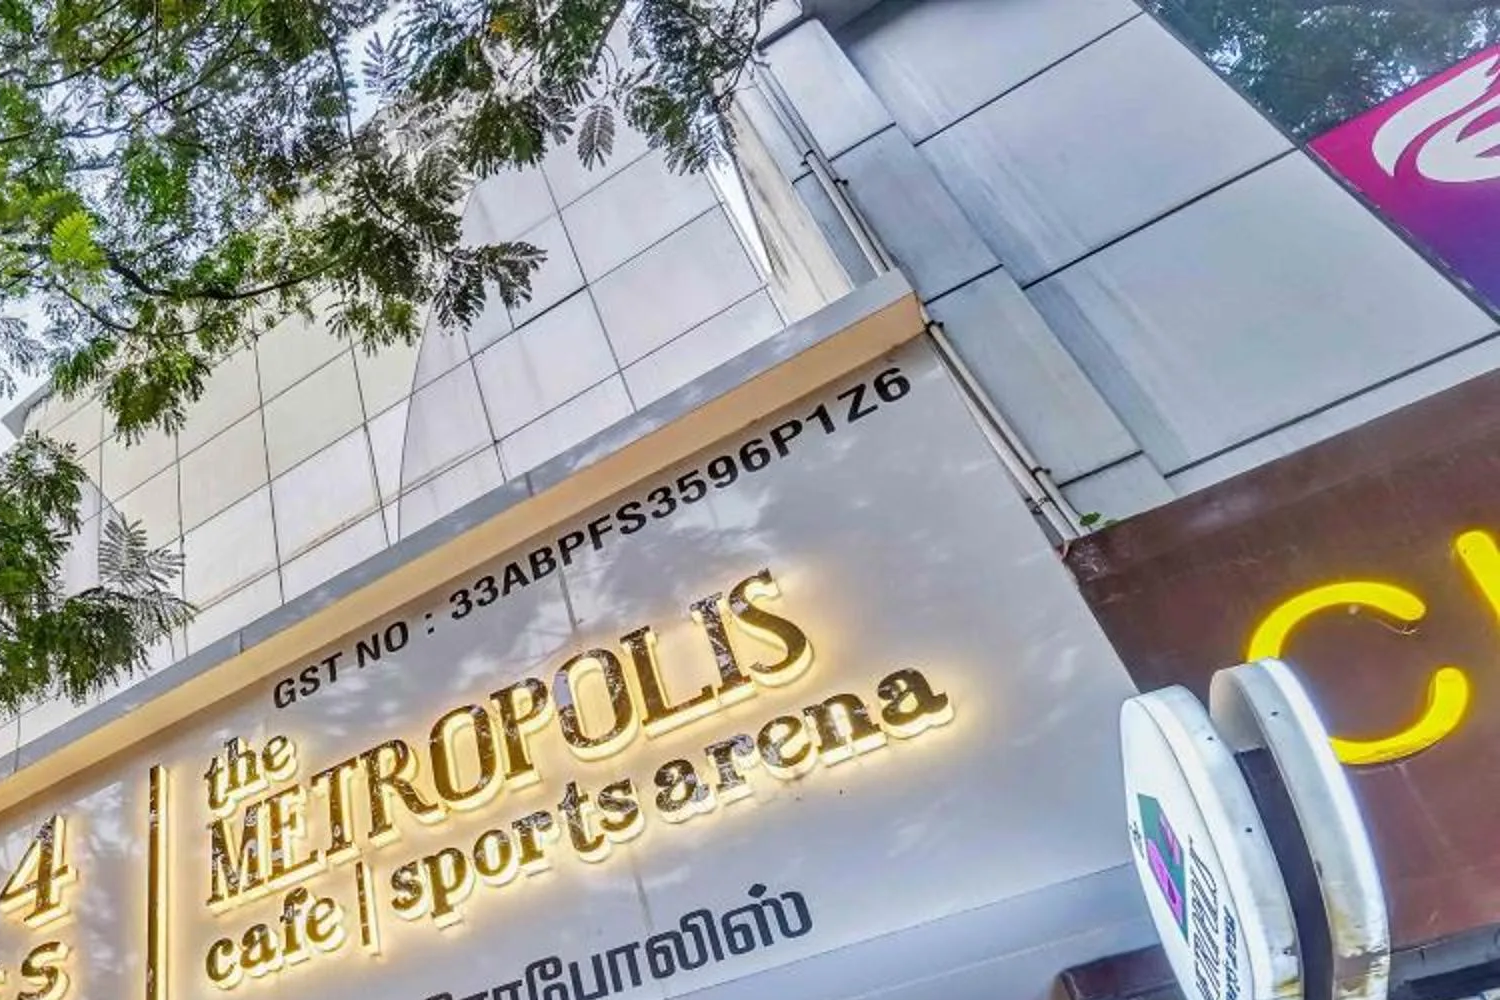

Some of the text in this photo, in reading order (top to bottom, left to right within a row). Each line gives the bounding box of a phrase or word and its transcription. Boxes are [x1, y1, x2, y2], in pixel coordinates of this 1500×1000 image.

[273, 652, 340, 711] GST
[357, 620, 410, 671] NO
[449, 366, 913, 622] 33ABPFS3596P1Z6
[204, 568, 812, 908] METROPOLIS
[204, 729, 294, 809] the
[204, 667, 950, 988] cafe sports arena
